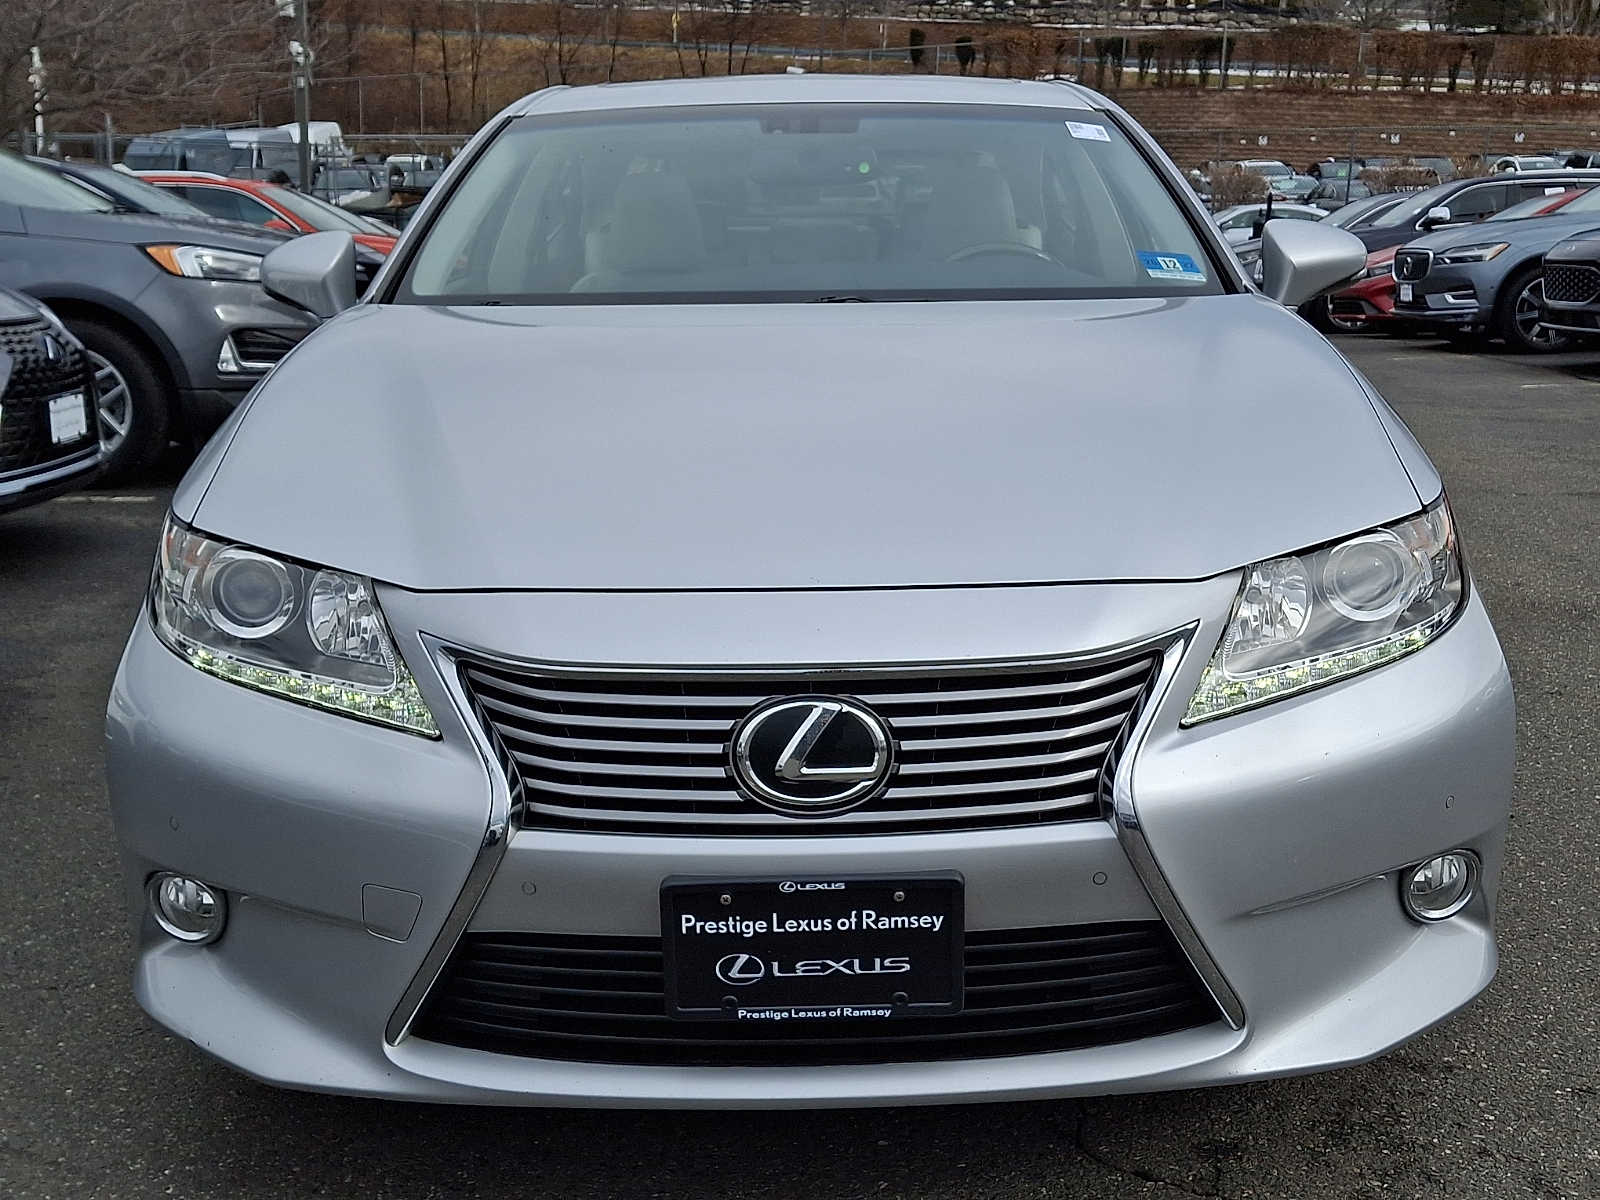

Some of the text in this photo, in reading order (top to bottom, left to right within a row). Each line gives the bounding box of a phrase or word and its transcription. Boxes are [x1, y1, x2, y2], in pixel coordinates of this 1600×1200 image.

[797, 882, 846, 891] LEXUS
[681, 910, 944, 937] Prestige Lexus of Ramsey
[771, 957, 911, 976] LEXUS
[738, 1007, 892, 1020] Prestige Lexus of Ramsey
